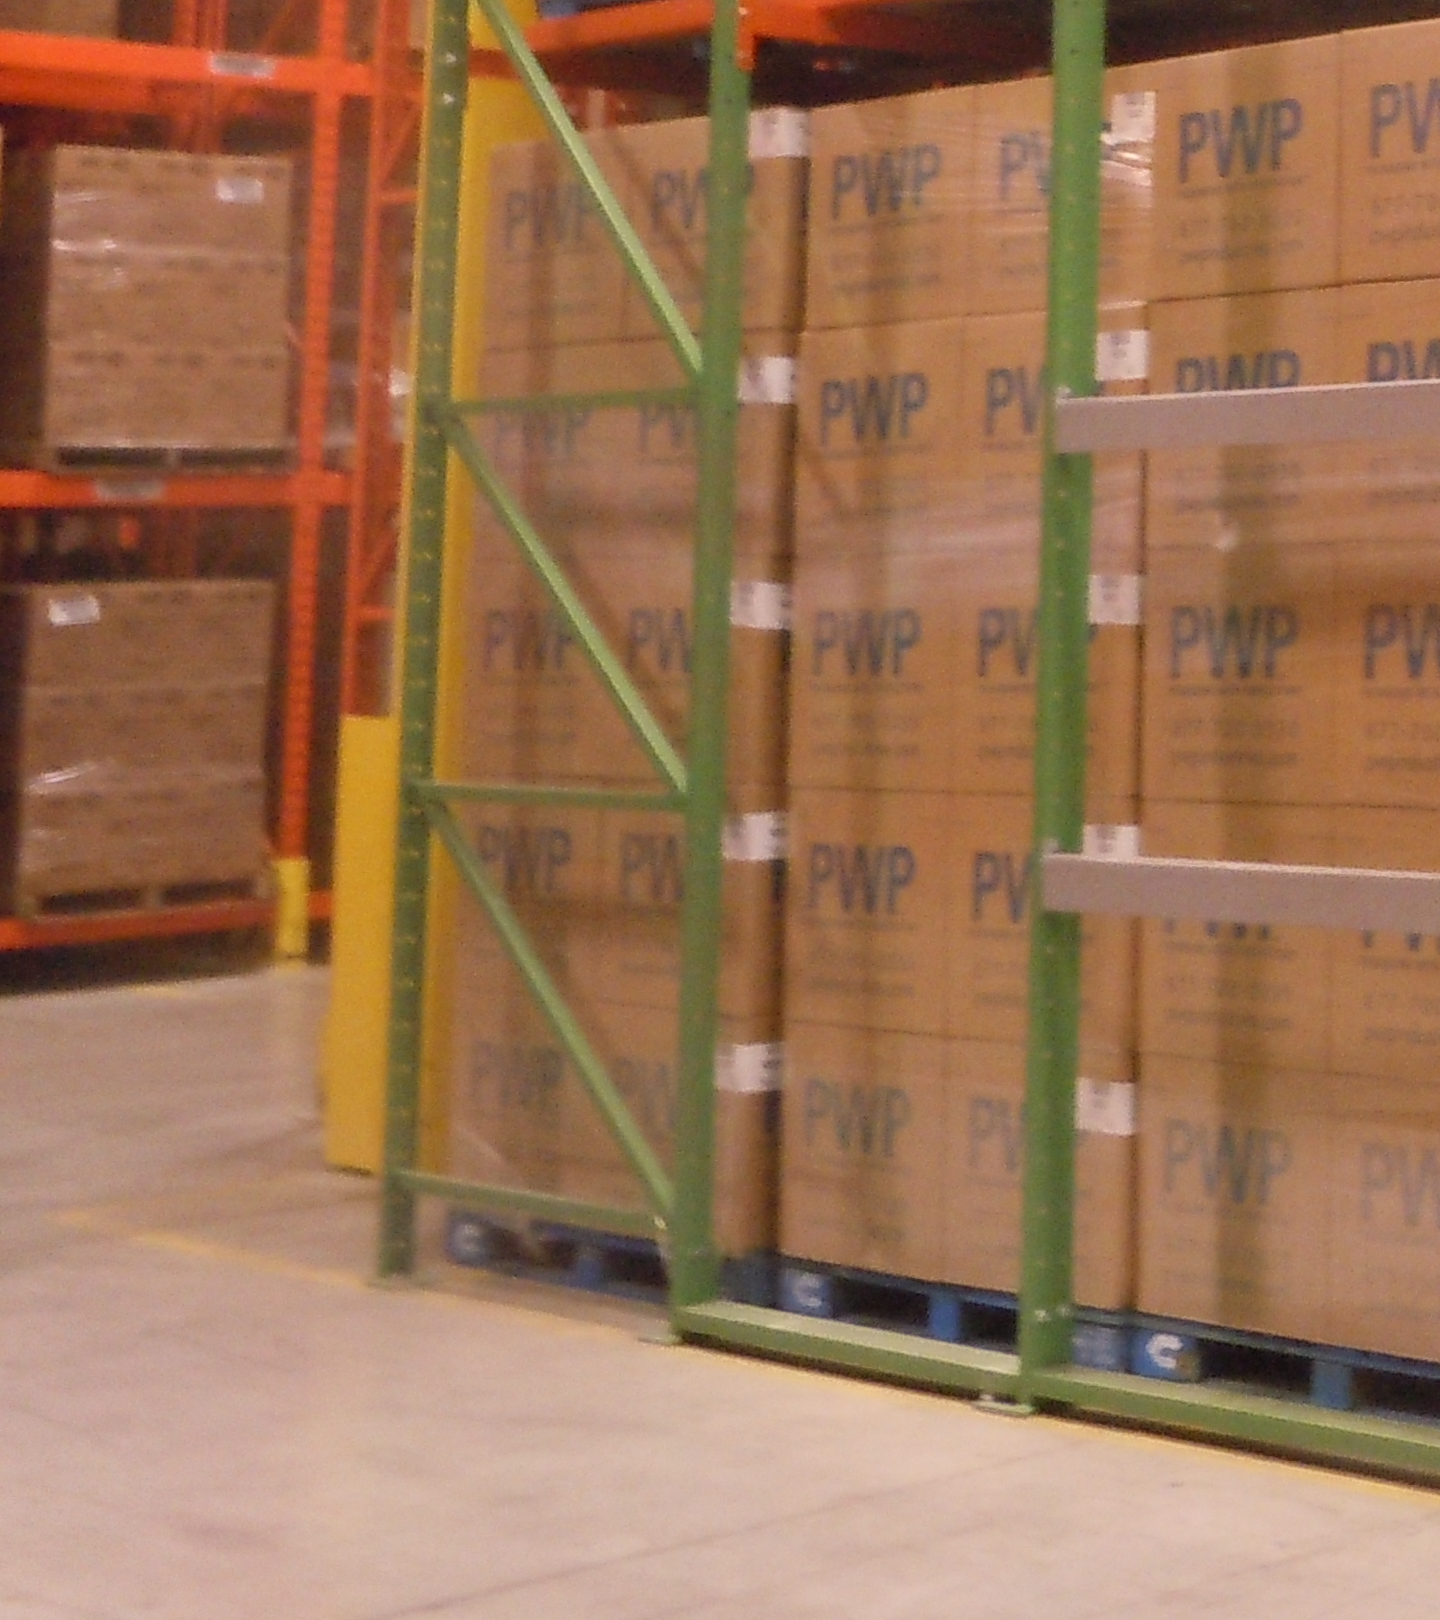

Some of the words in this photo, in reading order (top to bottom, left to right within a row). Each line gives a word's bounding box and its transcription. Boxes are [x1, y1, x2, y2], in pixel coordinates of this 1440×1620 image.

[1178, 98, 1301, 183] PWP
[831, 144, 941, 221] PWP
[819, 372, 928, 448] PWP
[628, 608, 694, 672] PW
[811, 608, 922, 677] PWP
[1169, 604, 1297, 680] PWP
[619, 833, 684, 899] PW
[808, 844, 918, 914] PWP
[805, 1080, 911, 1158] PWP
[1161, 1118, 1294, 1205] PWP
